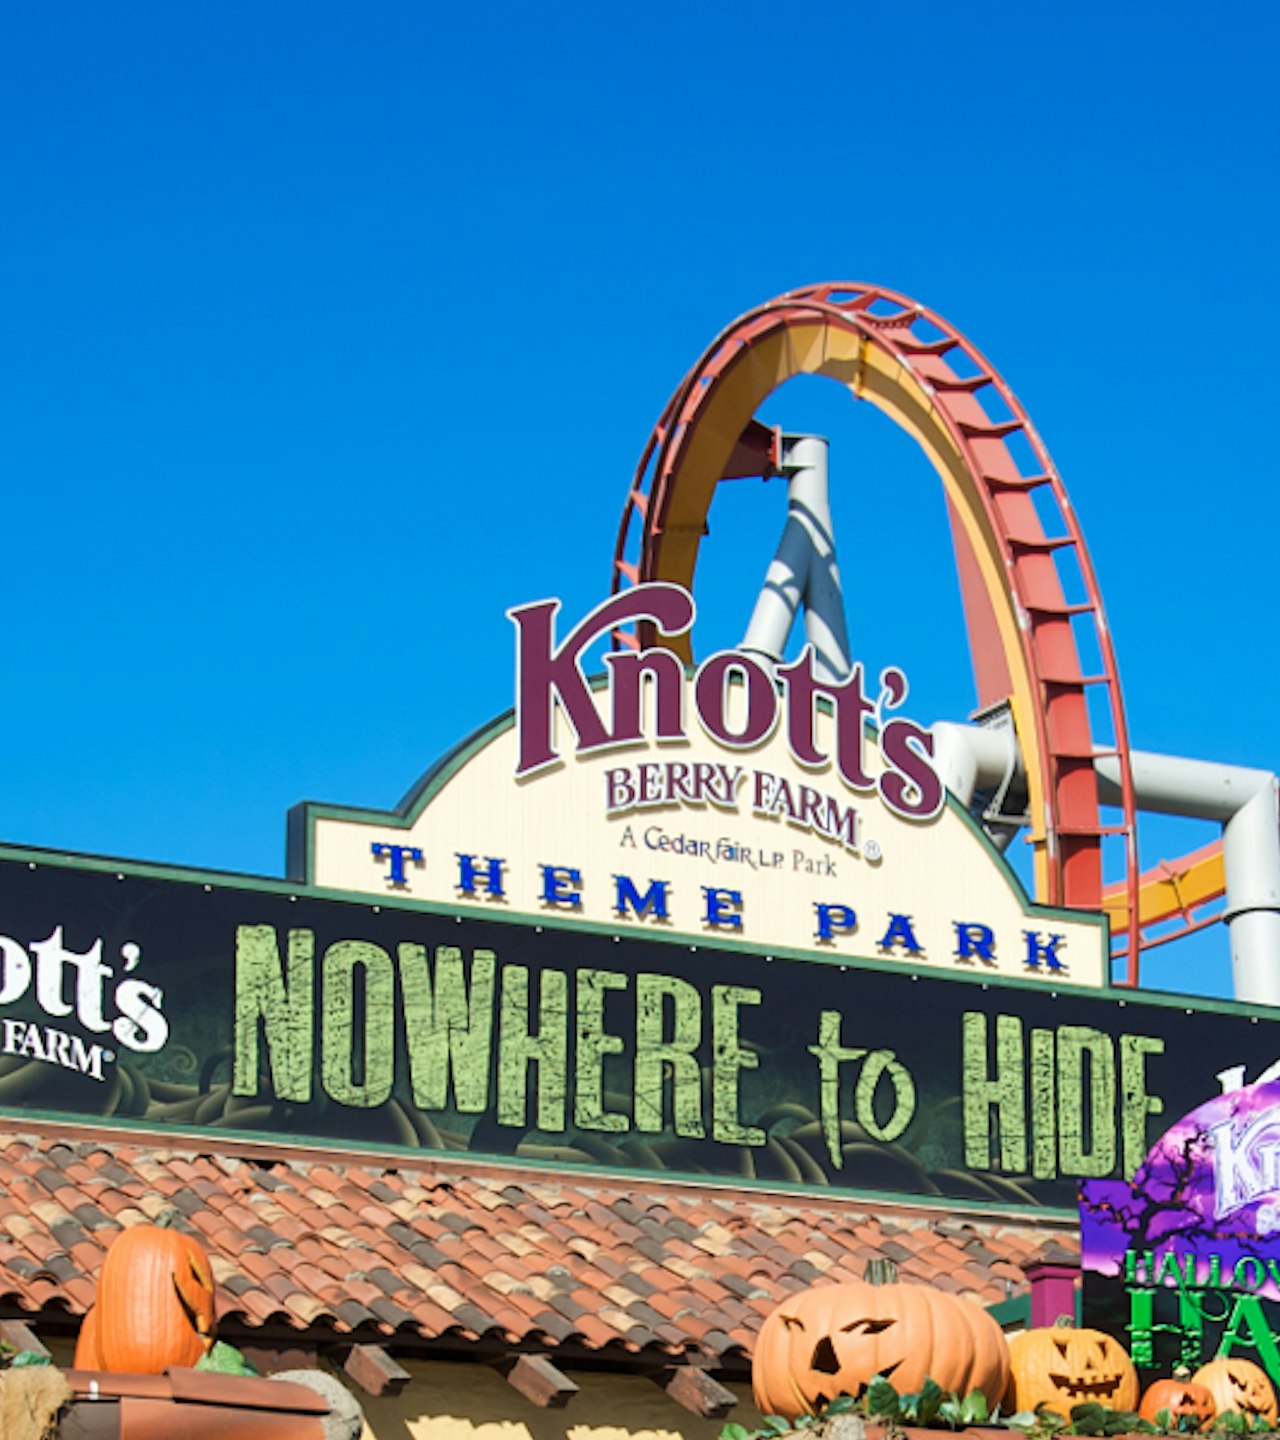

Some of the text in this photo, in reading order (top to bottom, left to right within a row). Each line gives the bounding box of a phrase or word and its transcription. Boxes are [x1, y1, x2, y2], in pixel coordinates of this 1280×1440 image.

[507, 581, 947, 821] Knott's
[604, 761, 859, 848] BERRY FARM
[619, 825, 638, 849] A
[644, 826, 716, 863] Cedar
[792, 849, 837, 877] Park
[371, 841, 1070, 972] THEME PARK
[2, 1017, 106, 1081] FARM
[232, 923, 768, 1147] NOWHERE
[807, 1009, 916, 1171] to
